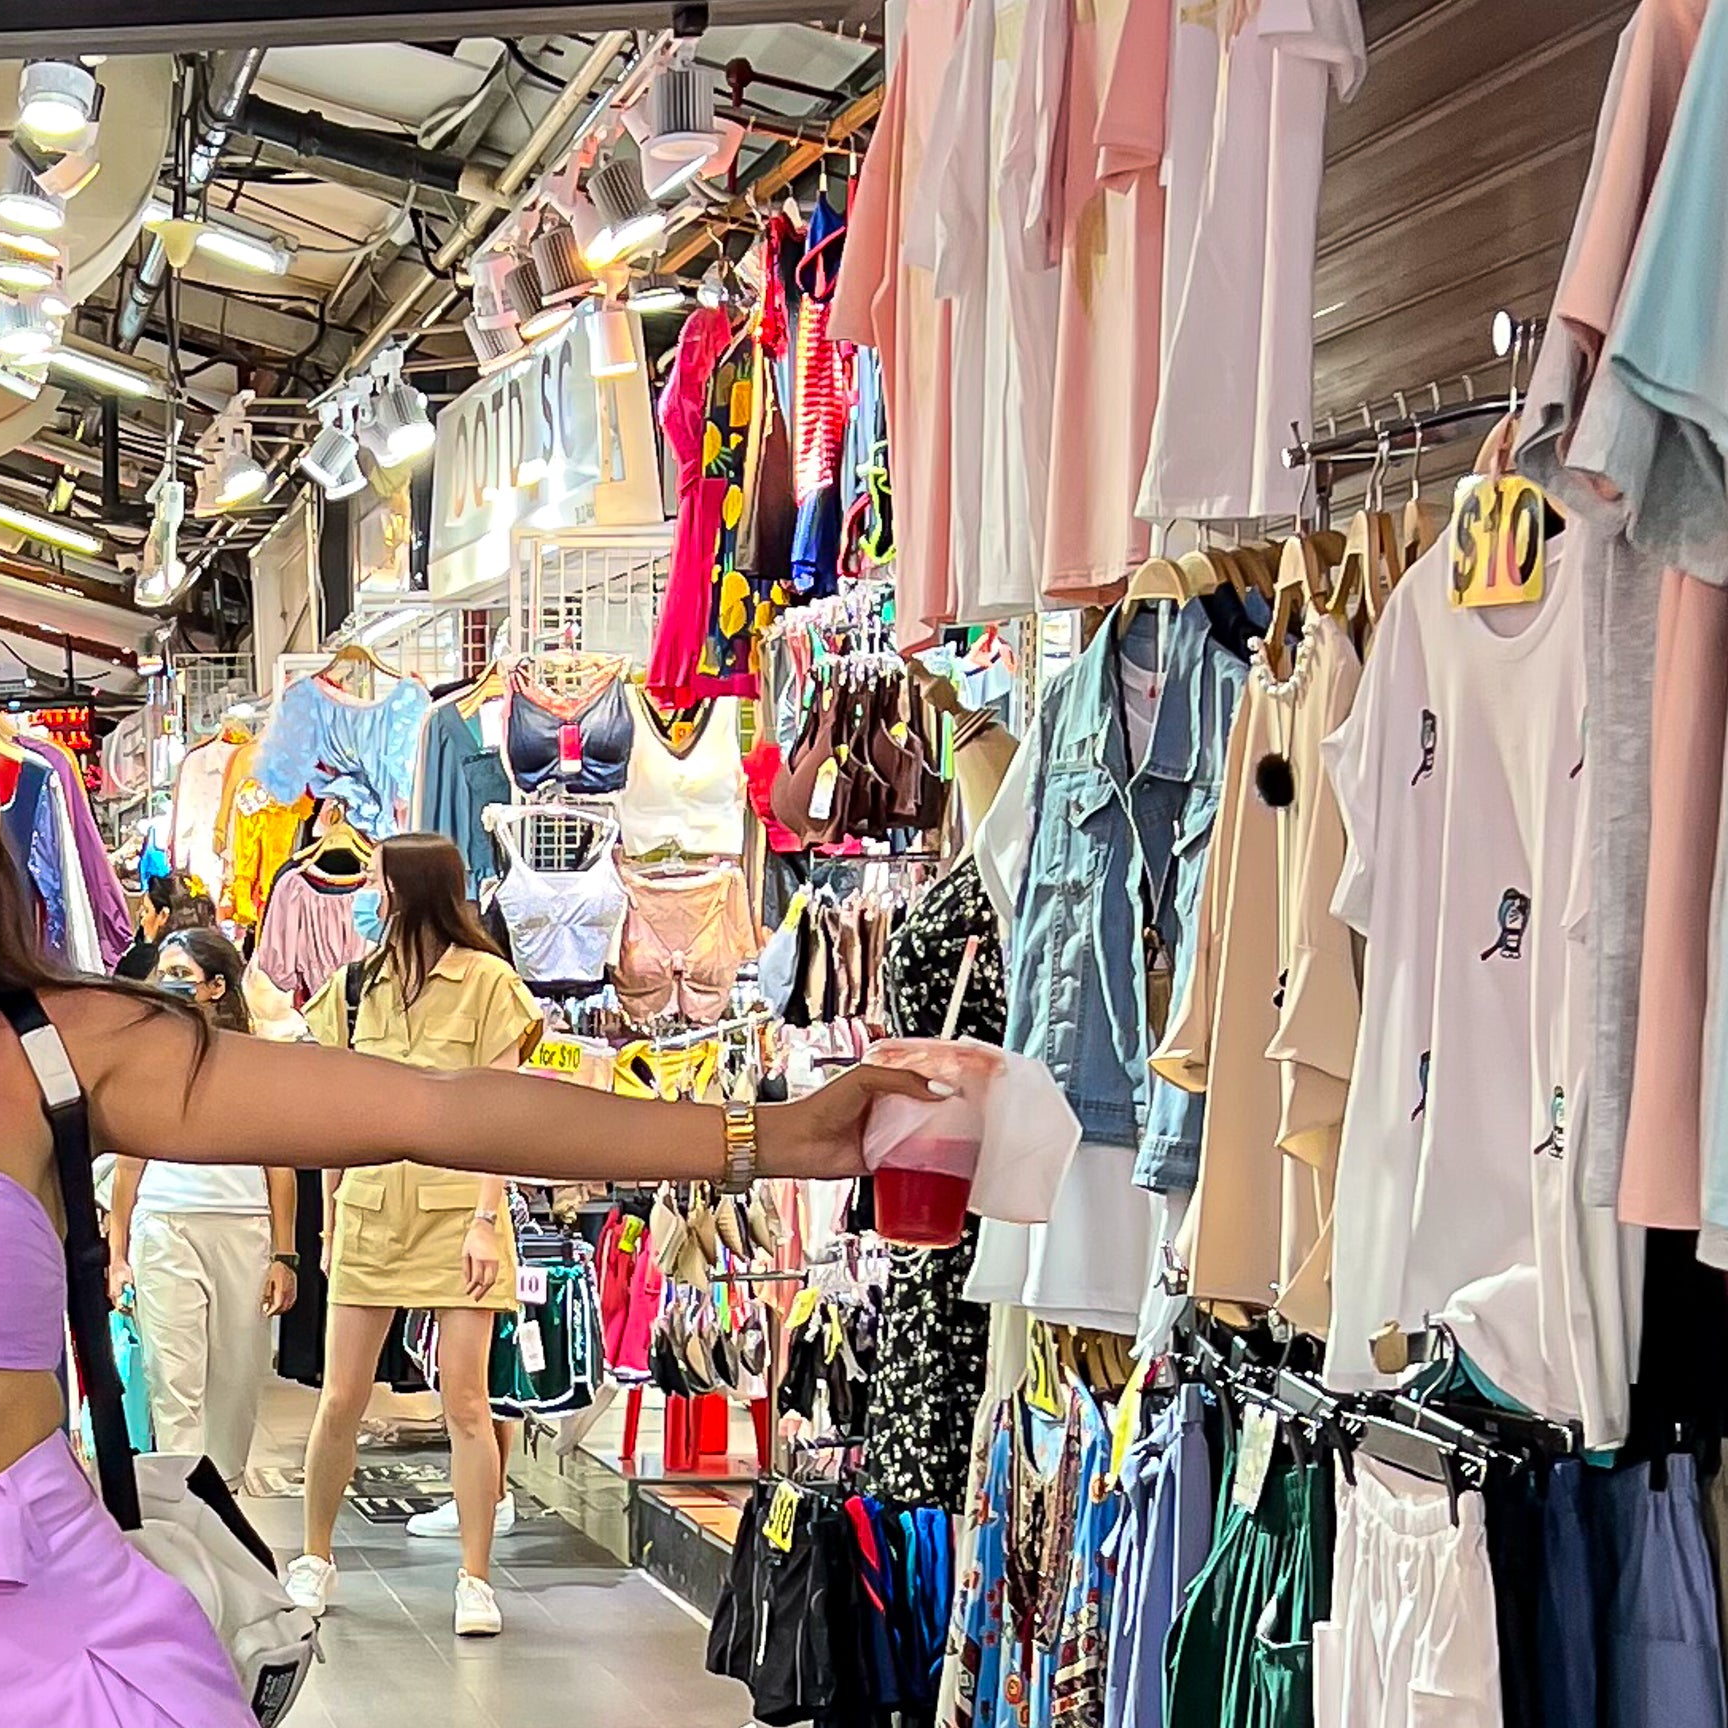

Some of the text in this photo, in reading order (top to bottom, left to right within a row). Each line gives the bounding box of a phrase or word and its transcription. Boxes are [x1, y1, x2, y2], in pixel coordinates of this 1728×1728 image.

[454, 377, 526, 520] OOTD
[1452, 486, 1540, 605] $10
[558, 1044, 581, 1069] $10
